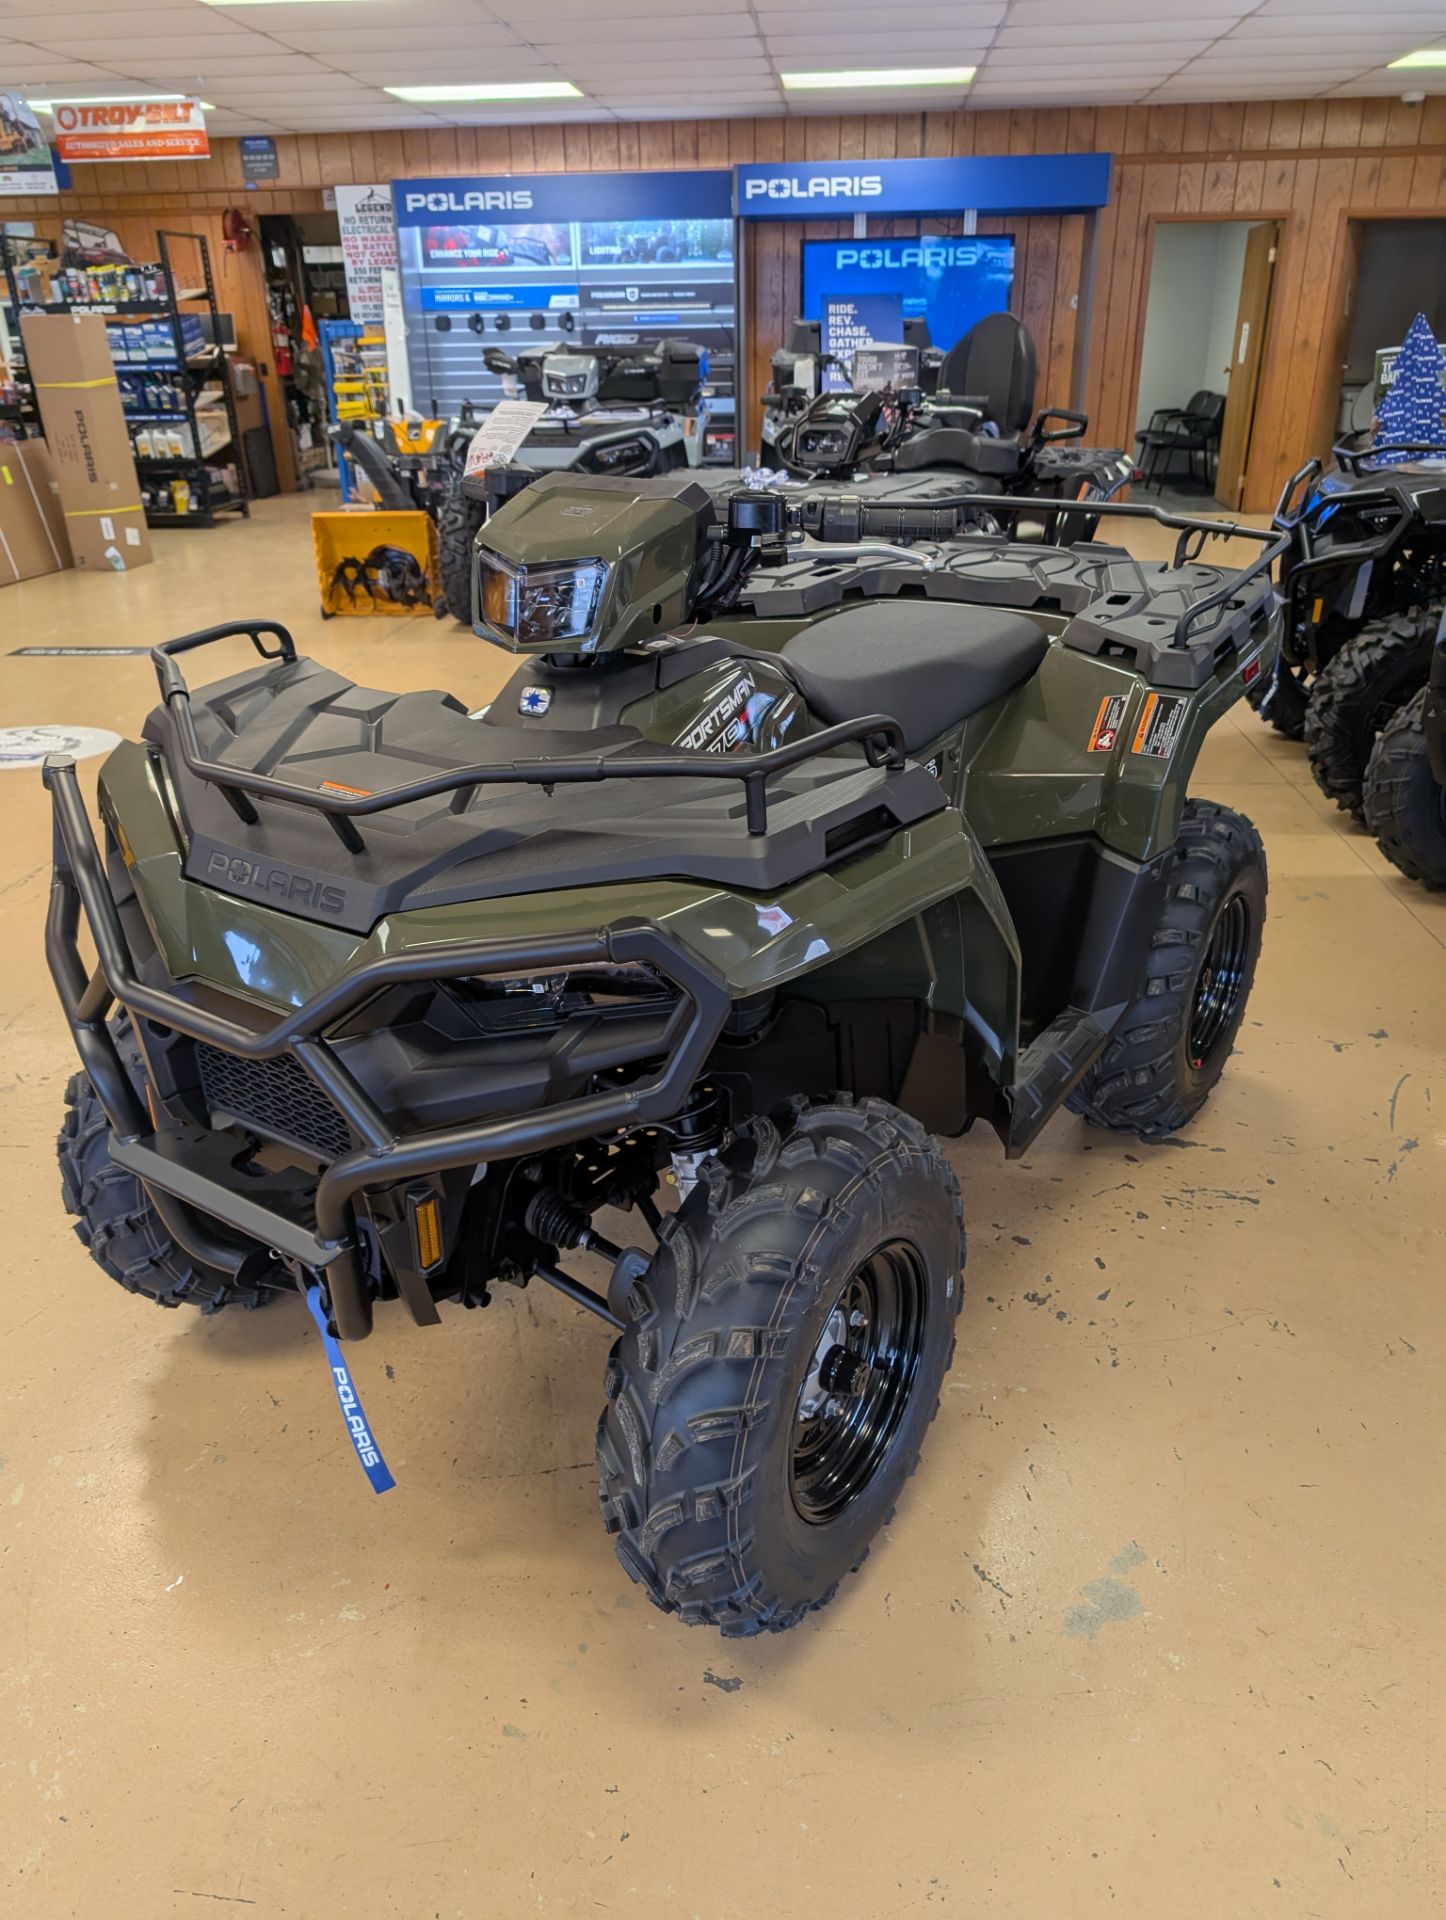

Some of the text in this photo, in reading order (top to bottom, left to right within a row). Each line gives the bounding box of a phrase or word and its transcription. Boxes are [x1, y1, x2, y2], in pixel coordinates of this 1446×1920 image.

[78, 102, 195, 126] TROY-BILT
[745, 175, 882, 199] POLARIS
[406, 190, 533, 212] POLARIS
[342, 225, 388, 234] ELECTRICAL
[344, 216, 356, 225] NO
[343, 235, 357, 243] NO
[836, 245, 978, 270] POLARIS
[828, 303, 858, 315] RIDE.
[828, 315, 854, 326] REV.
[828, 326, 870, 337] CHASE.
[74, 409, 98, 484] POLARIS
[207, 850, 347, 914] POLARIS
[332, 1366, 380, 1468] POLARIS
